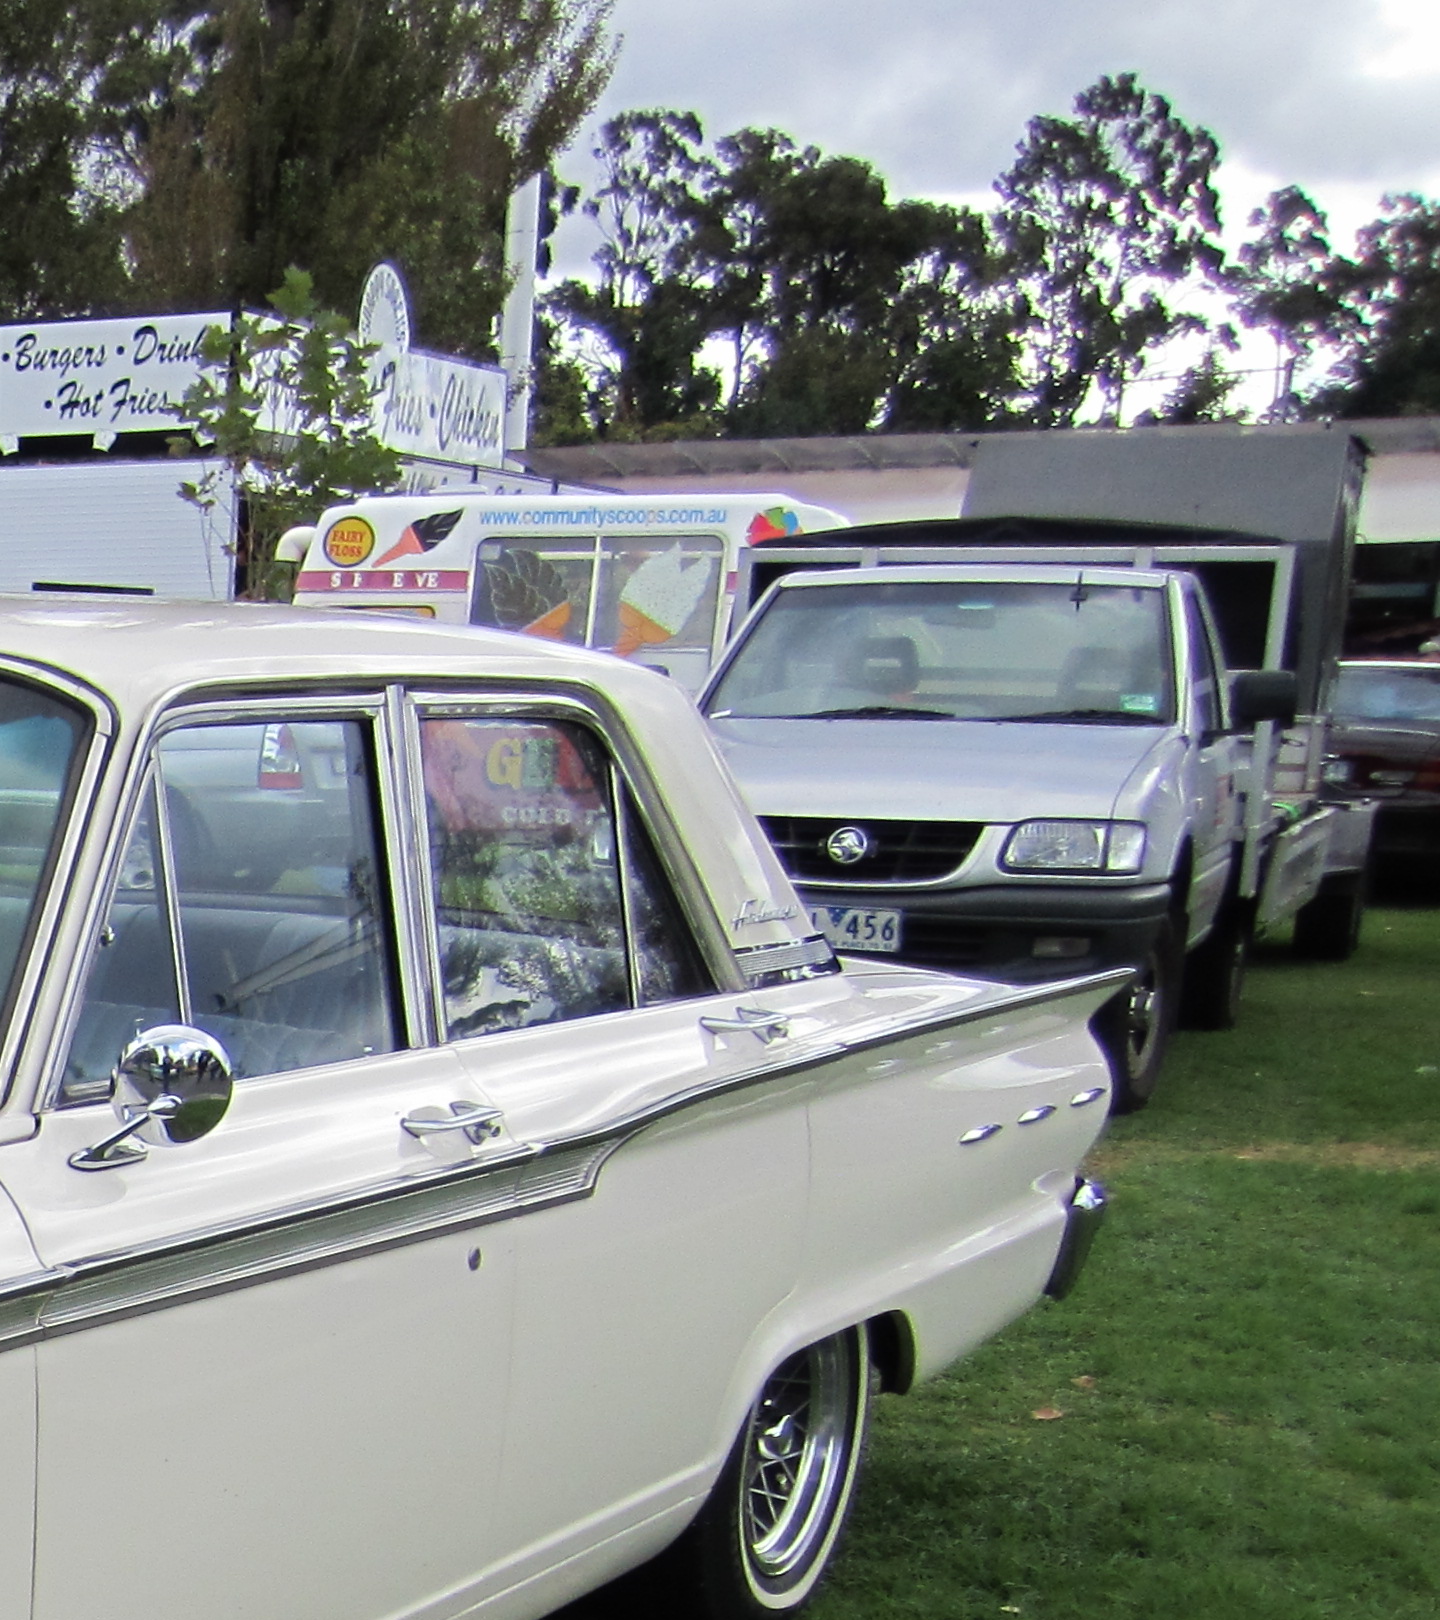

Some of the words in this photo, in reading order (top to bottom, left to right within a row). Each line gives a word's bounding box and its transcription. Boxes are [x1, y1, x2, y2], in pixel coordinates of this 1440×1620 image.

[15, 332, 107, 377] Burgers
[57, 380, 103, 421] Hot
[109, 377, 170, 423] Fries
[438, 372, 500, 452] Chicken
[479, 506, 727, 528] www.communityscoops.com.au
[331, 530, 367, 543] FAIRY
[328, 545, 363, 558] FLOSS
[845, 912, 896, 941] 456
